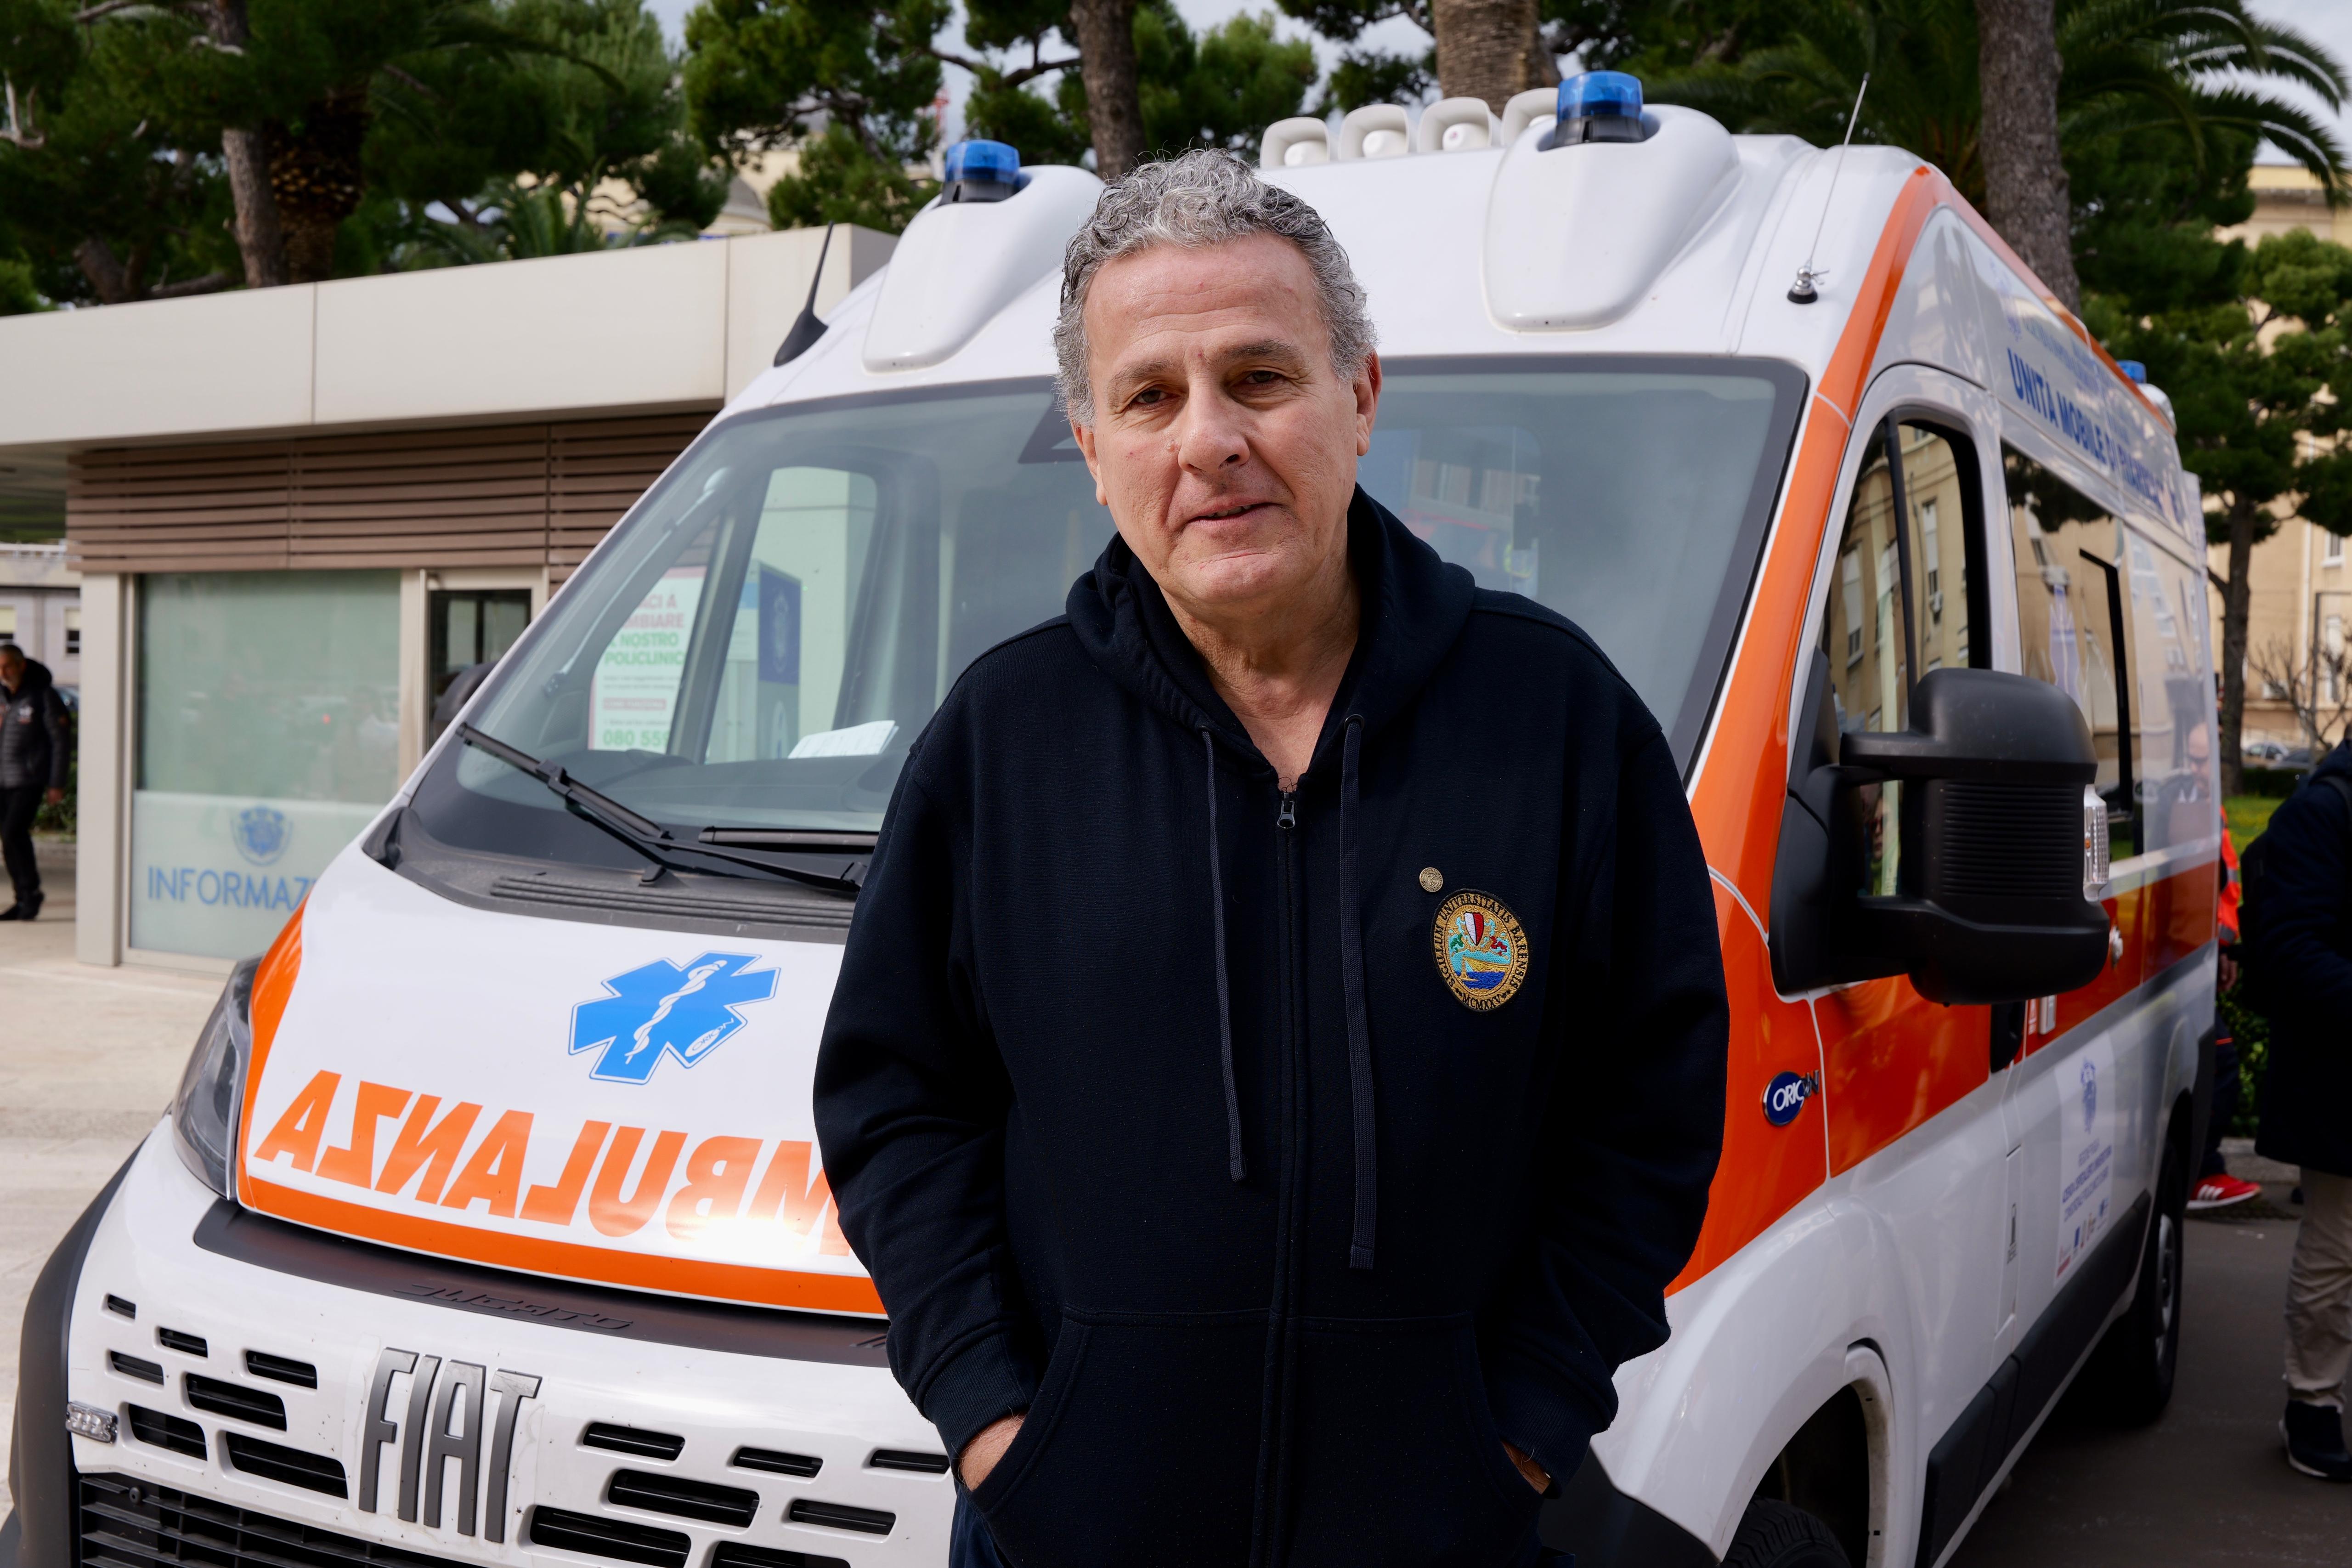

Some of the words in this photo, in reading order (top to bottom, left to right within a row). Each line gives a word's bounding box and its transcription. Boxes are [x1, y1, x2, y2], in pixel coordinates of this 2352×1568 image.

[621, 632, 678, 647] NOSTRO
[604, 651, 684, 665] POLICLINIC
[603, 730, 635, 746] 080
[148, 865, 317, 912] INFORMAZ
[1434, 923, 1455, 987] SIGILLUM
[1510, 925, 1528, 989] BARENSIS
[1462, 992, 1501, 1010] MCMXXV
[692, 1018, 734, 1051] ORION
[394, 1285, 633, 1329] DUCATO
[359, 1347, 543, 1543] FIAT
